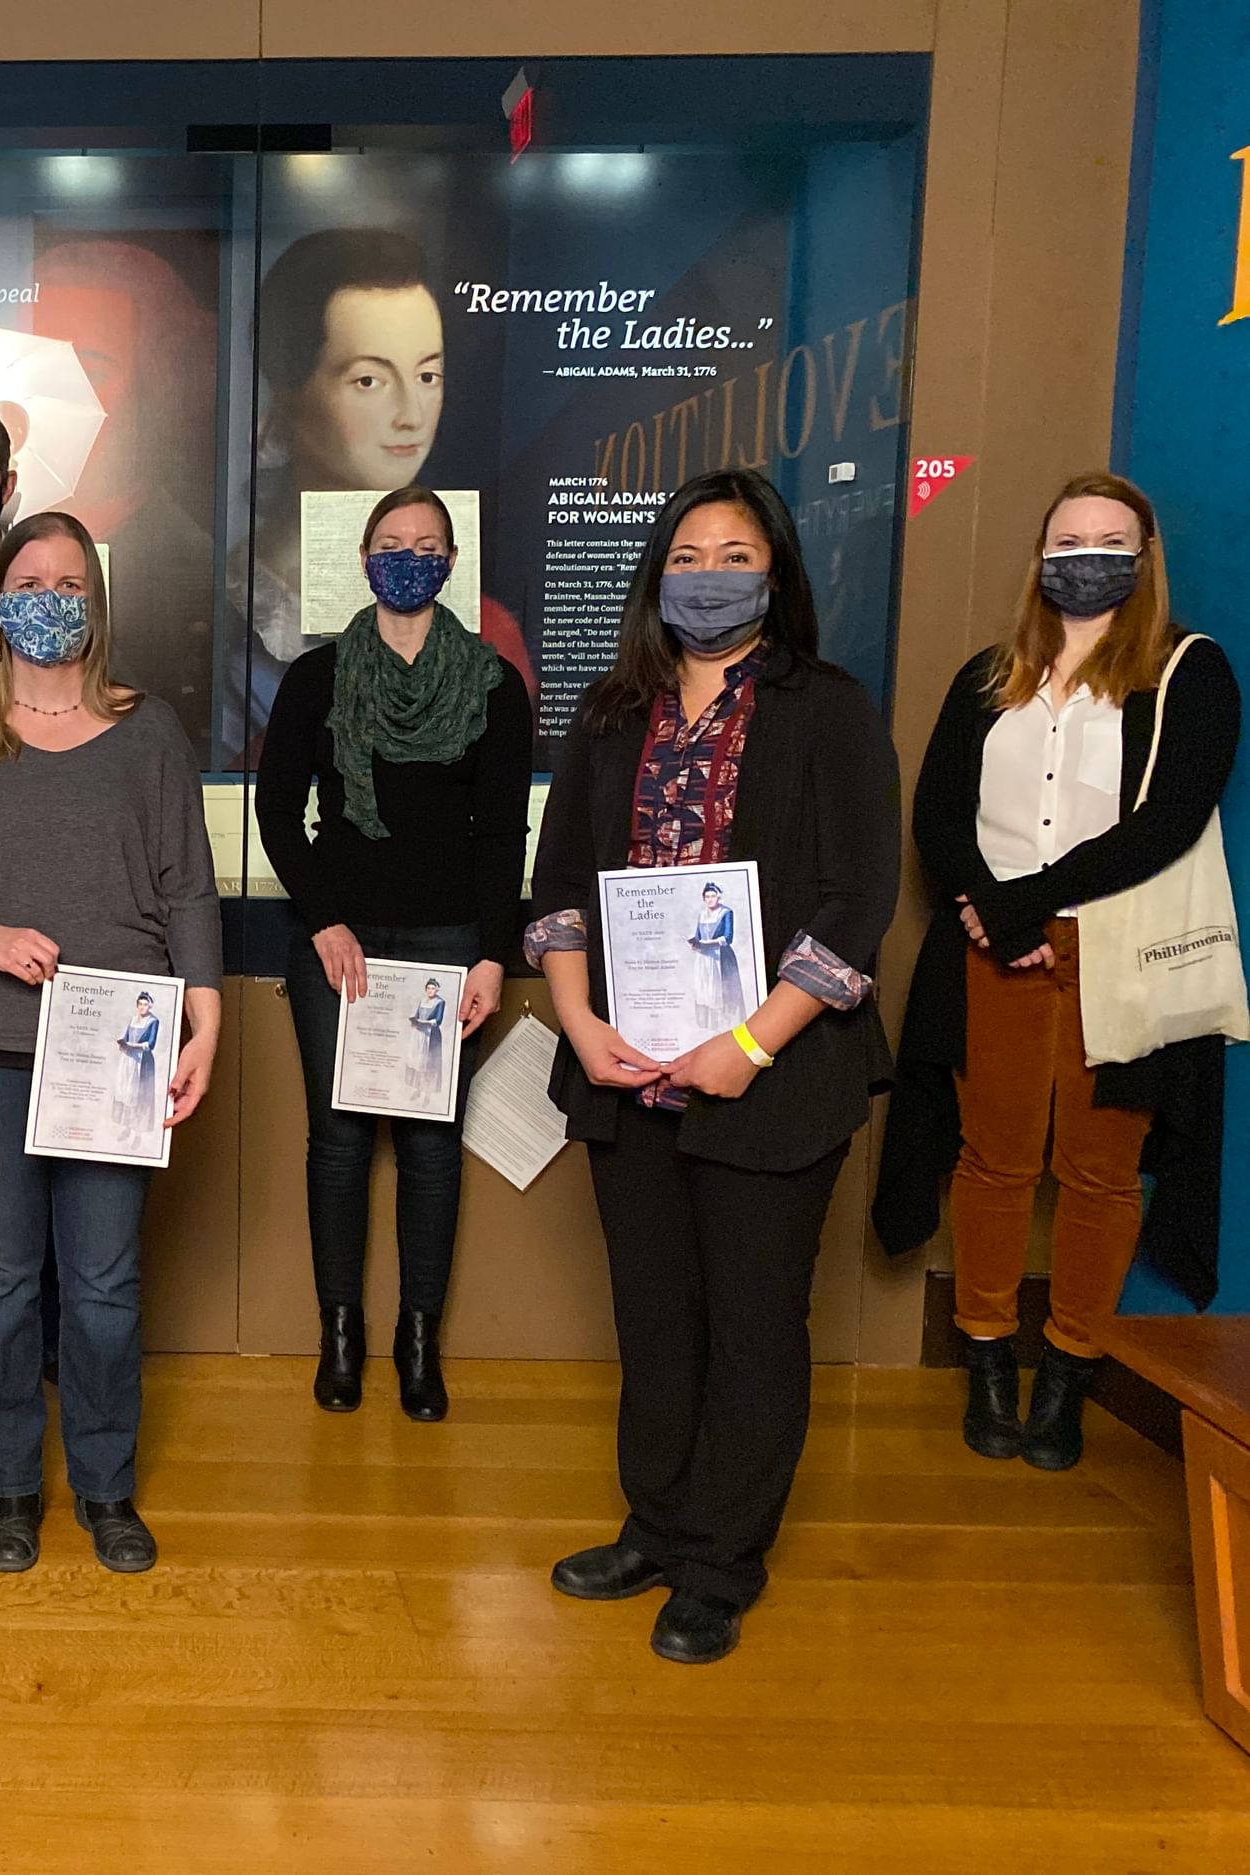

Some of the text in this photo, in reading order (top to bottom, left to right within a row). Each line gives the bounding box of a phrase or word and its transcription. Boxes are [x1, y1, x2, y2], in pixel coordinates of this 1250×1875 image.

[454, 281, 655, 313] "Remember
[557, 318, 773, 349] the Ladies..."
[555, 366, 717, 378] ABIGAIL ADAMS, March 31, 1776
[915, 459, 955, 478] 205
[549, 477, 608, 487] MARCH 1776
[548, 492, 666, 505] ABIGAIL ADAMS
[548, 511, 656, 524] FOR WOMEN'S
[545, 564, 599, 573] Revolutionary
[544, 581, 556, 589] On
[557, 581, 582, 589] March
[595, 581, 615, 589] 1776,
[616, 884, 676, 898] Remember
[637, 898, 655, 909] the
[629, 909, 665, 921] Ladies
[1144, 930, 1233, 963] PhilHarmonia
[62, 981, 115, 997] Remember
[375, 982, 389, 991] the
[367, 989, 396, 1000] Ladies
[79, 996, 95, 1006] the
[71, 1005, 102, 1018] Ladies
